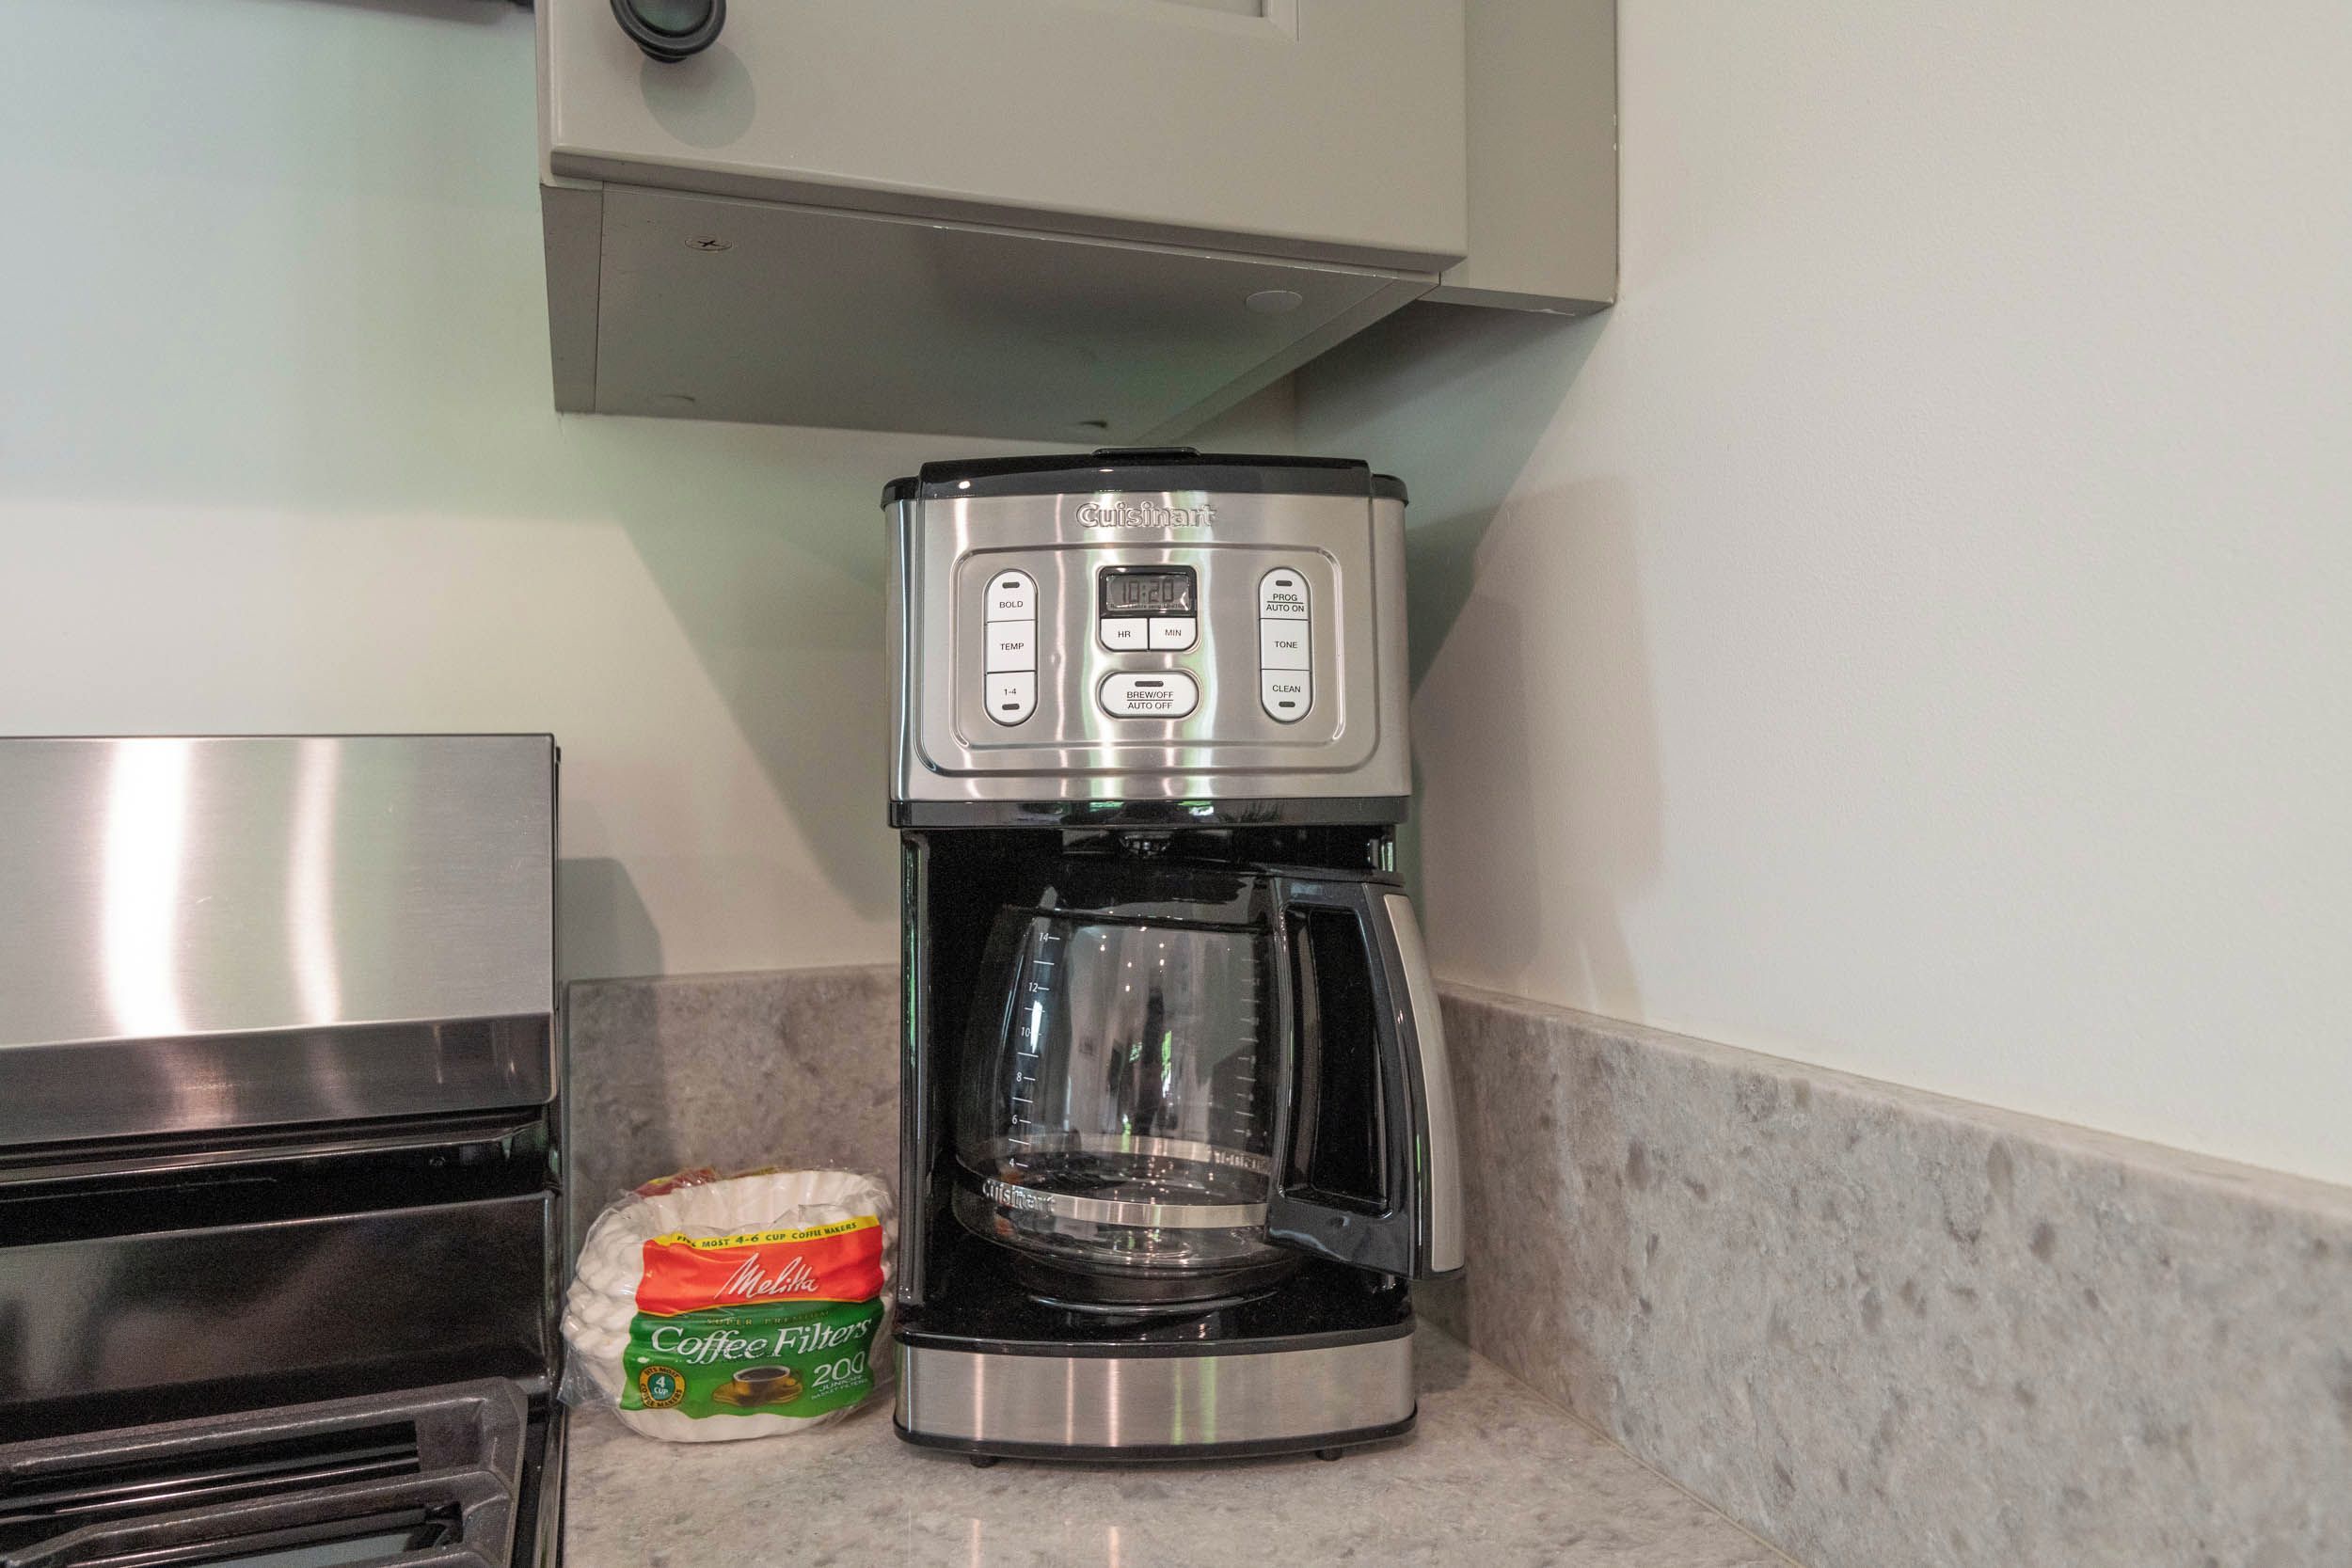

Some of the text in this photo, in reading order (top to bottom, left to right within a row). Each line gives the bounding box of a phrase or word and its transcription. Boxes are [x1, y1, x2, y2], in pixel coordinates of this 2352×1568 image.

[1076, 501, 1216, 528] Cuisinart
[1121, 578, 1174, 604] 10:20
[1272, 593, 1298, 602] PROG
[999, 599, 1024, 610] BOLD
[1265, 604, 1305, 613] AUTO ON
[1117, 629, 1131, 639] HR
[1165, 628, 1182, 638] MIN
[1000, 642, 1025, 651] TEMP
[1274, 641, 1298, 649] TONE
[1003, 688, 1017, 696] 1-4
[1272, 684, 1301, 693] CLEAN
[1126, 690, 1174, 699] BREW/OFF
[1127, 702, 1172, 710] AUTO OFF
[1039, 932, 1049, 942] 14
[1028, 982, 1039, 992] 12
[1021, 1026, 1031, 1037] 10
[1016, 1071, 1023, 1082] 8
[1011, 1115, 1018, 1125] 6
[1009, 1158, 1015, 1167] 4
[702, 1238, 730, 1248] MOST
[736, 1234, 759, 1244] 4-6
[766, 1233, 787, 1242] CUP
[824, 1222, 857, 1235] MAKERS
[713, 1252, 819, 1300] Melitta
[651, 1318, 872, 1364] Coffee Filters
[812, 1350, 866, 1387] 200
[656, 1376, 666, 1388] 4
[654, 1386, 669, 1396] CUP
